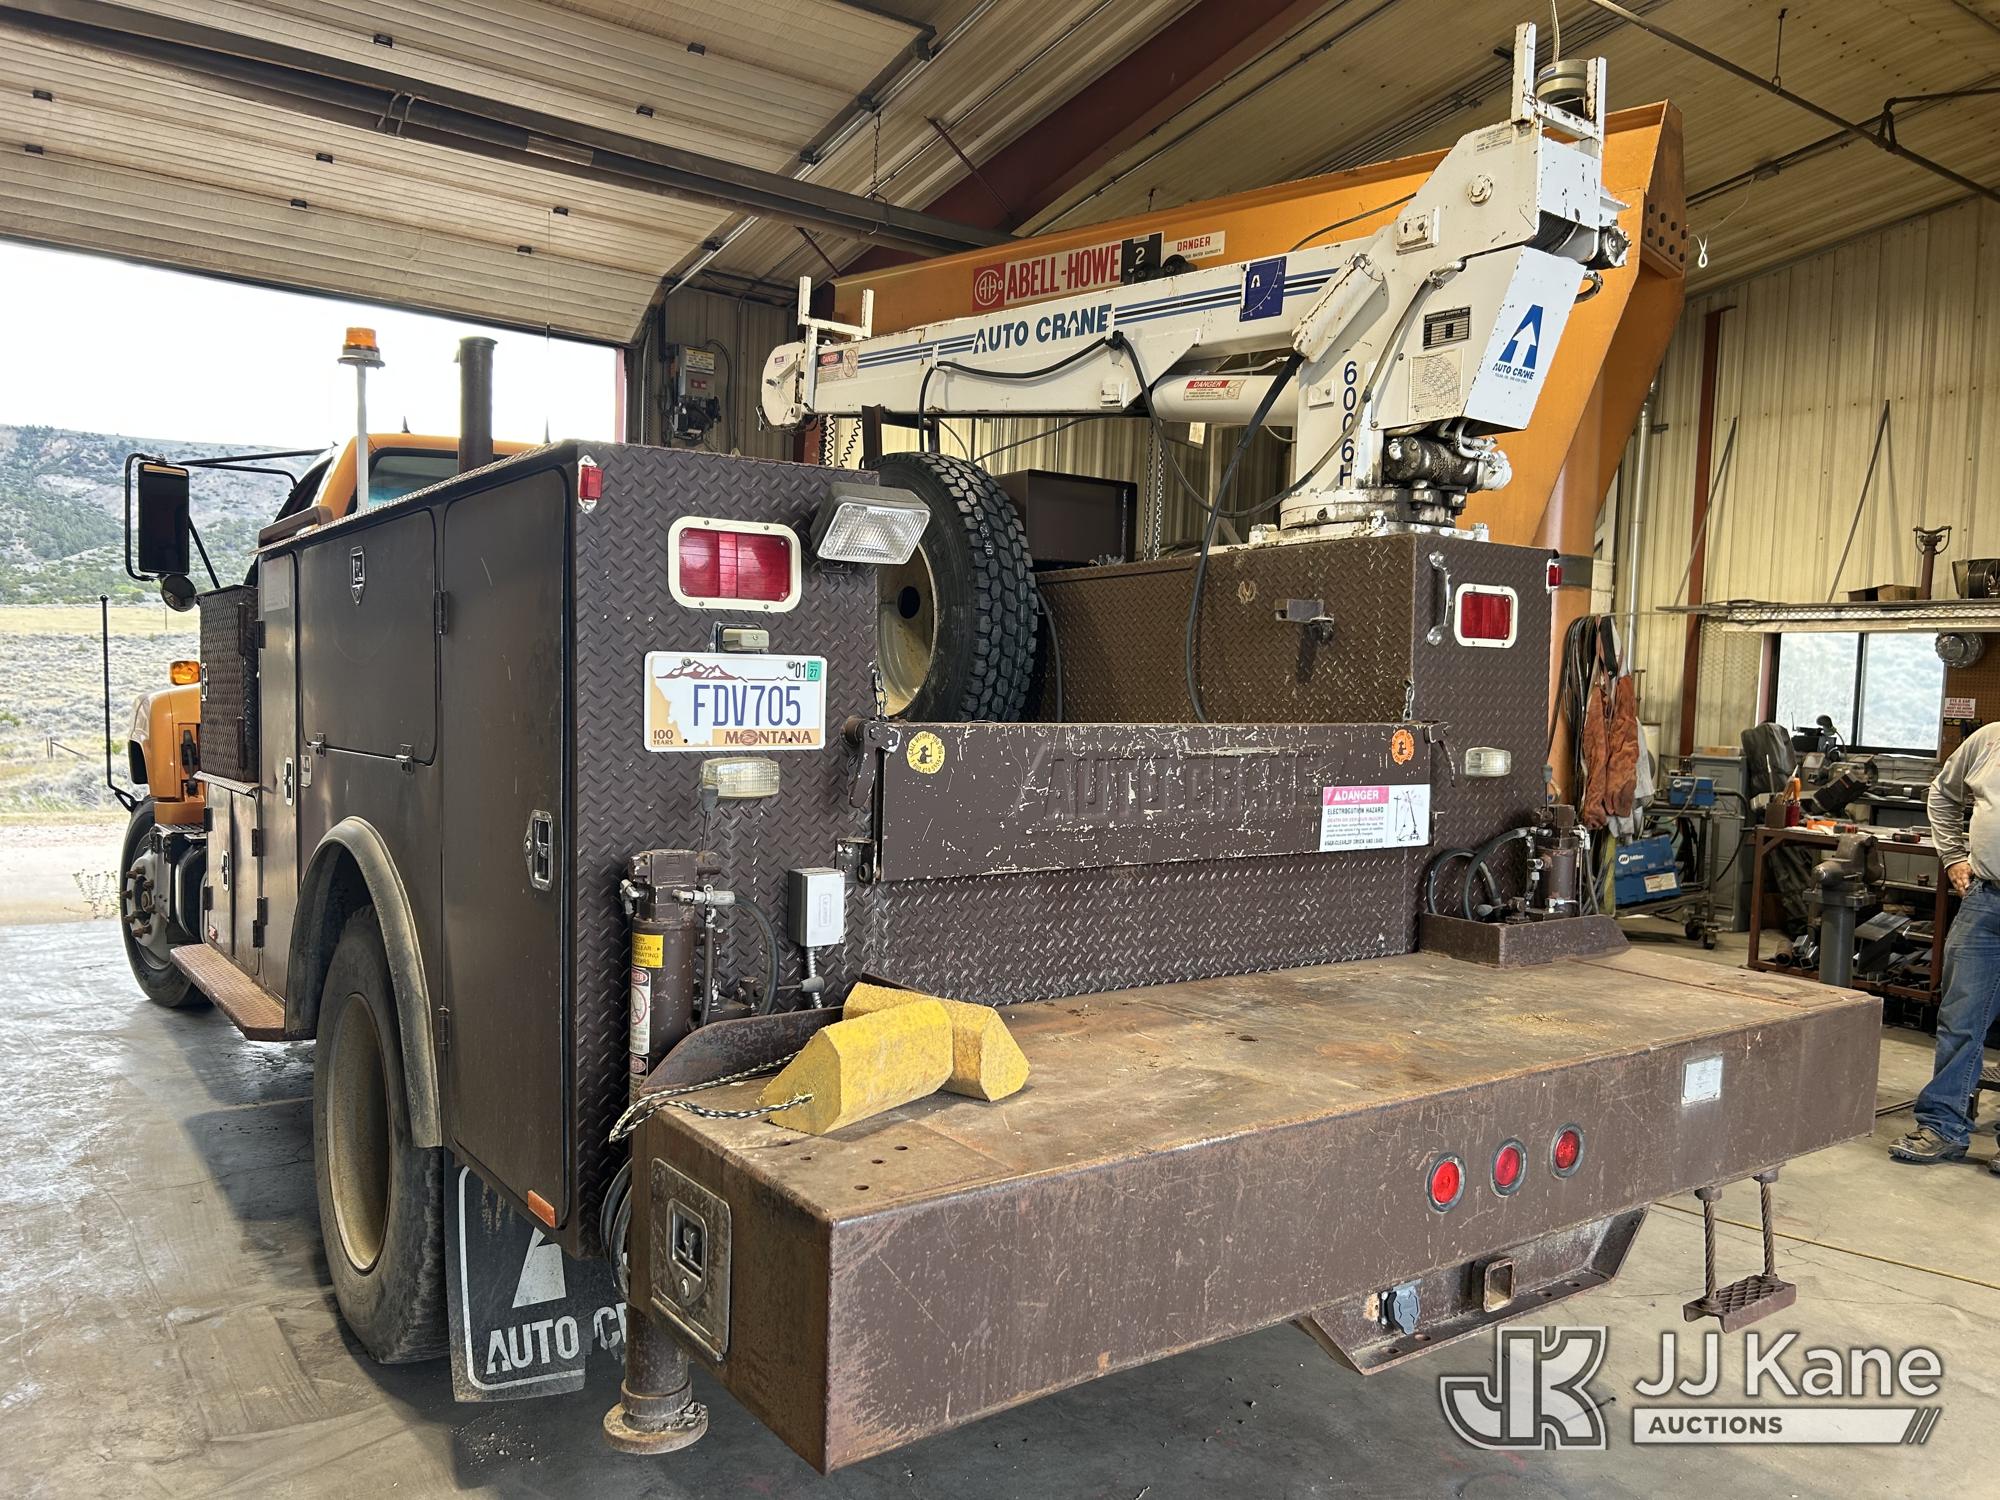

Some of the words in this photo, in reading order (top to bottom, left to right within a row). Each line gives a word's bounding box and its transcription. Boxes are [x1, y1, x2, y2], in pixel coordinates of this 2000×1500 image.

[1177, 236, 1211, 252] DANGER
[1135, 247, 1145, 265] 2
[1006, 244, 1122, 304] ABELL-HOWE
[972, 320, 1029, 355] AUTO
[1036, 304, 1112, 343] CRANE
[1492, 362, 1511, 374] AUTO
[1512, 368, 1535, 380] CRANE
[810, 668, 818, 678] 27
[693, 685, 801, 726] FDV705
[653, 729, 674, 740] 100
[724, 729, 813, 745] MONTANA
[1341, 790, 1379, 801] DANGER
[1327, 807, 1365, 815] ELECTROCUTION
[486, 1316, 580, 1375] AUTO
